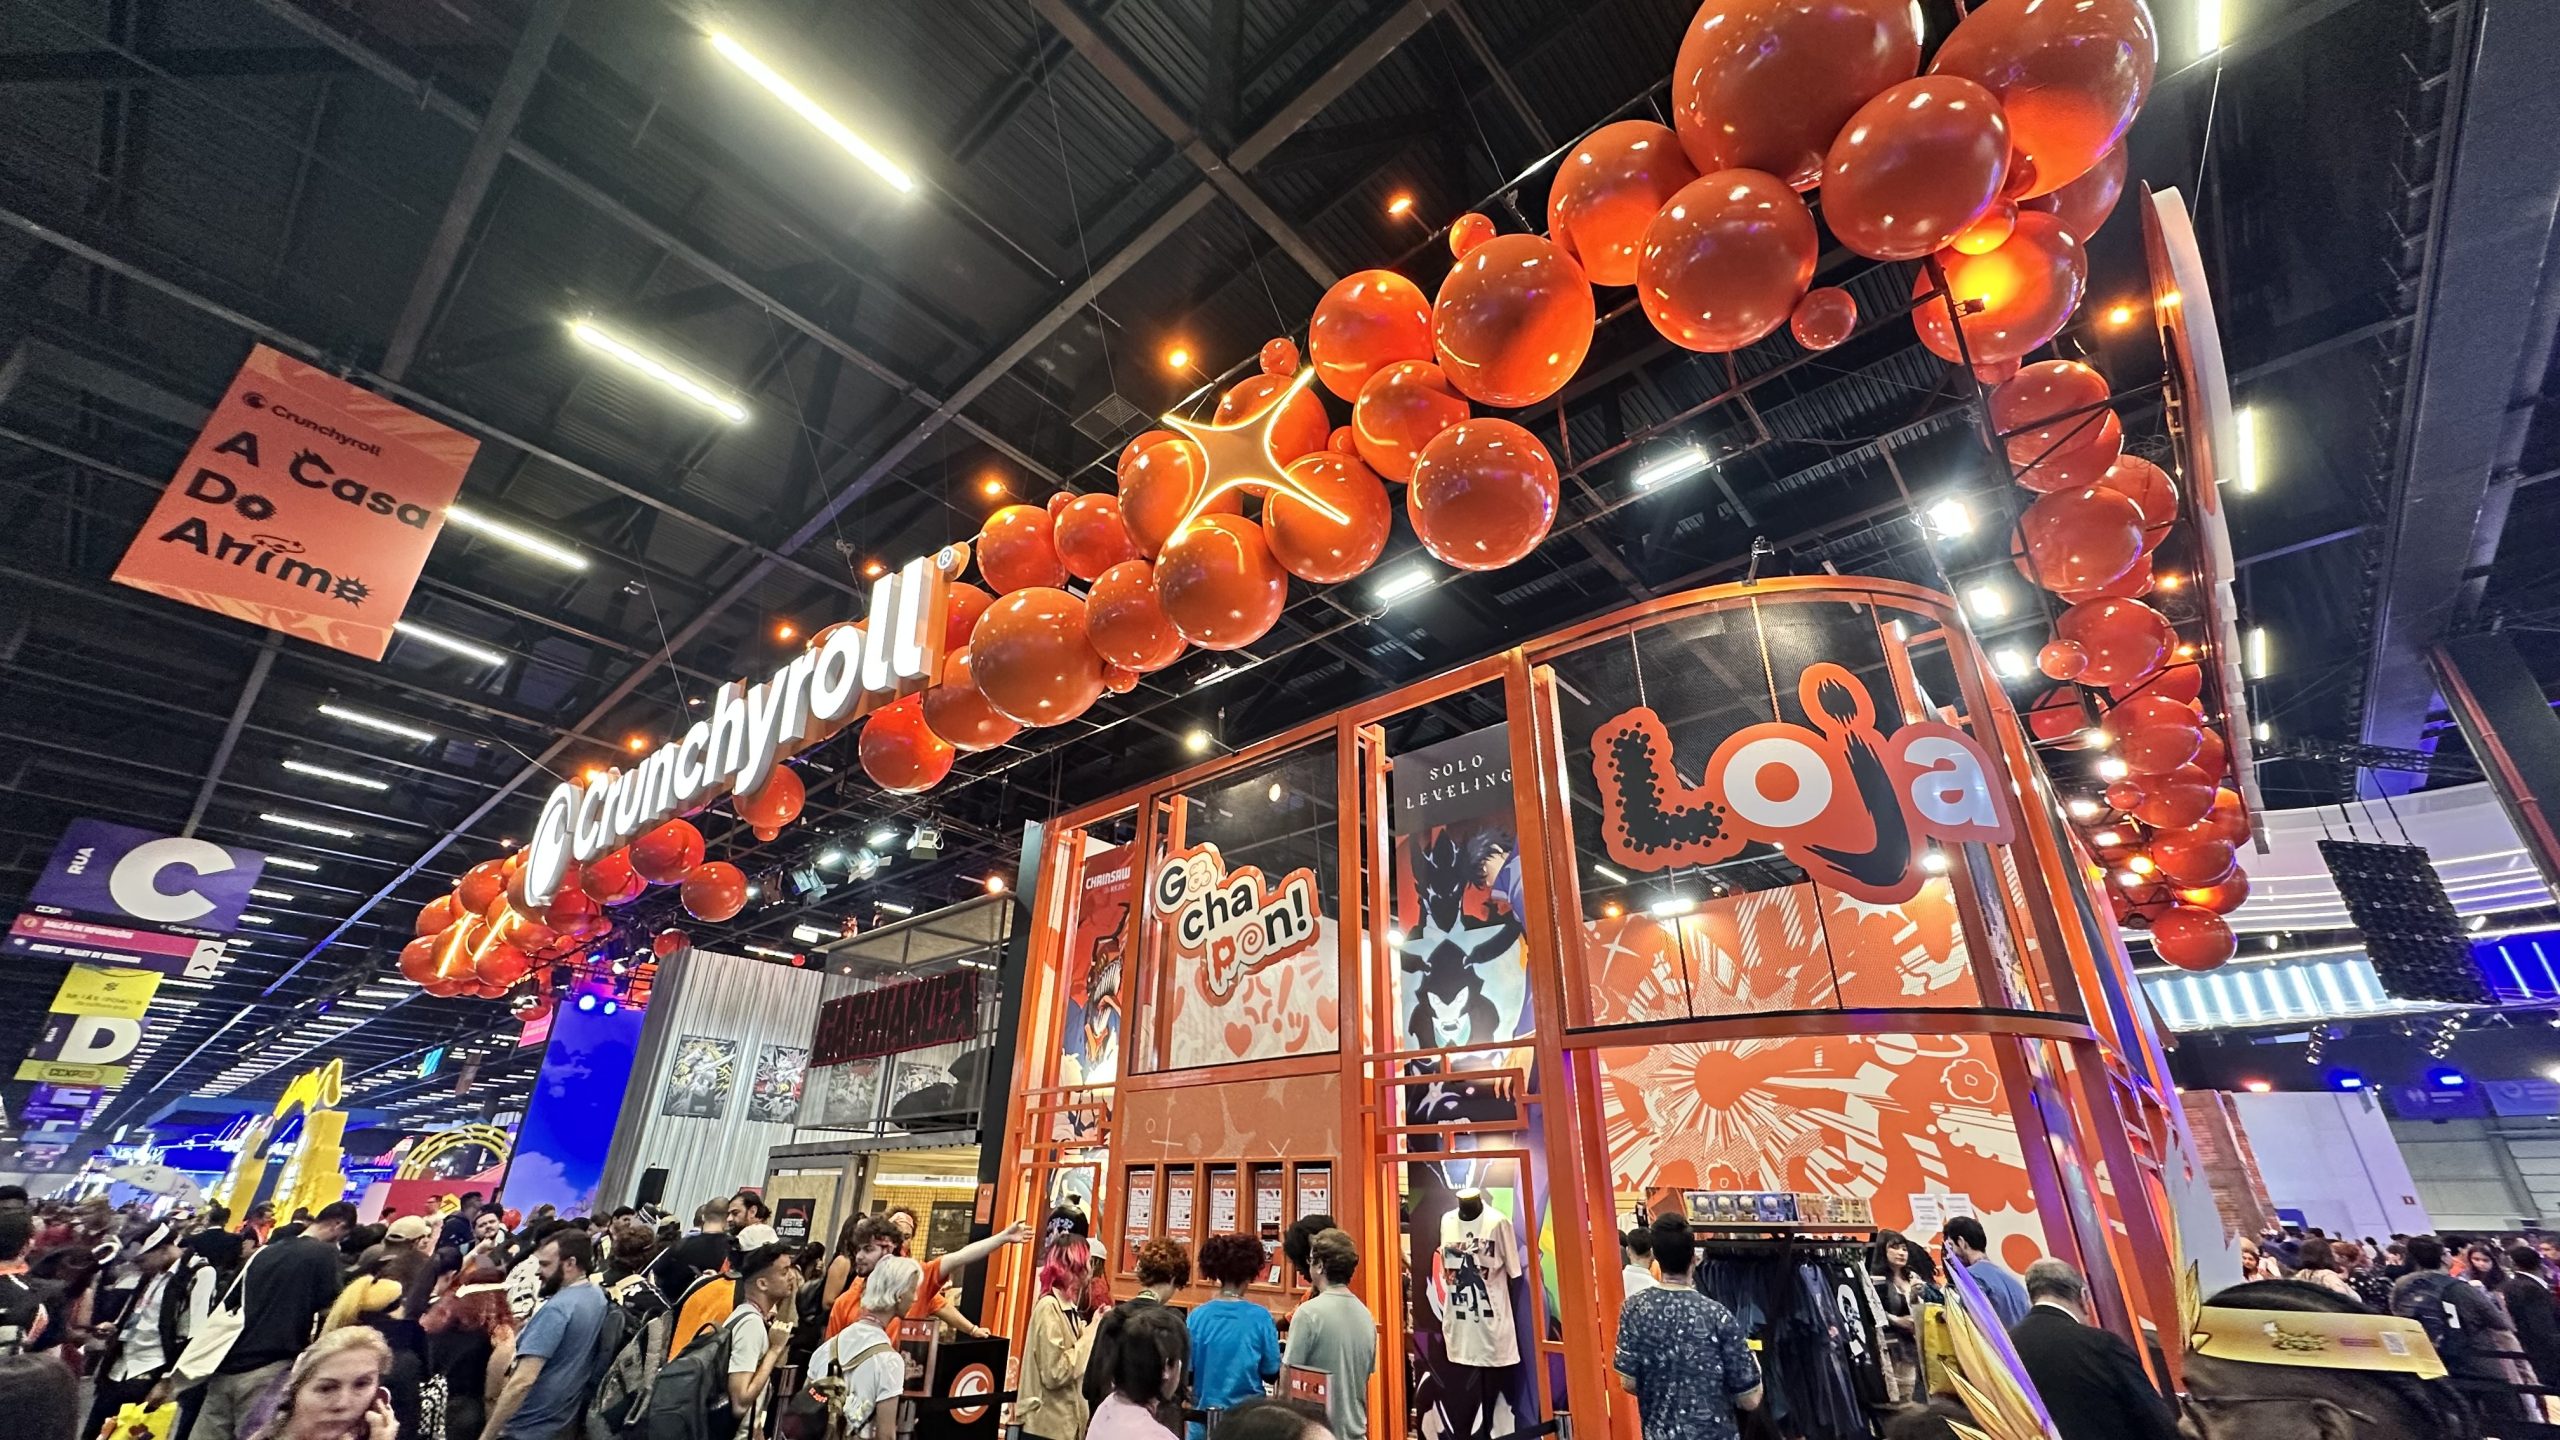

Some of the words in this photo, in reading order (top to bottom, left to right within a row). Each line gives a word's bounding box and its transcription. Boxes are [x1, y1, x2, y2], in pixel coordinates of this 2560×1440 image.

[271, 404, 382, 457] Crunchyroll
[184, 467, 277, 522] Do
[213, 431, 260, 468] A
[289, 448, 432, 530] Casa
[158, 516, 374, 610] Anime
[1405, 768, 1512, 810] LEVELING
[1429, 754, 1484, 781] SOLO
[1611, 679, 2001, 887] Loja
[67, 847, 95, 875] RUA
[109, 837, 236, 922] C
[1085, 865, 1131, 890] CHAINSAW
[56, 1013, 141, 1065] D
